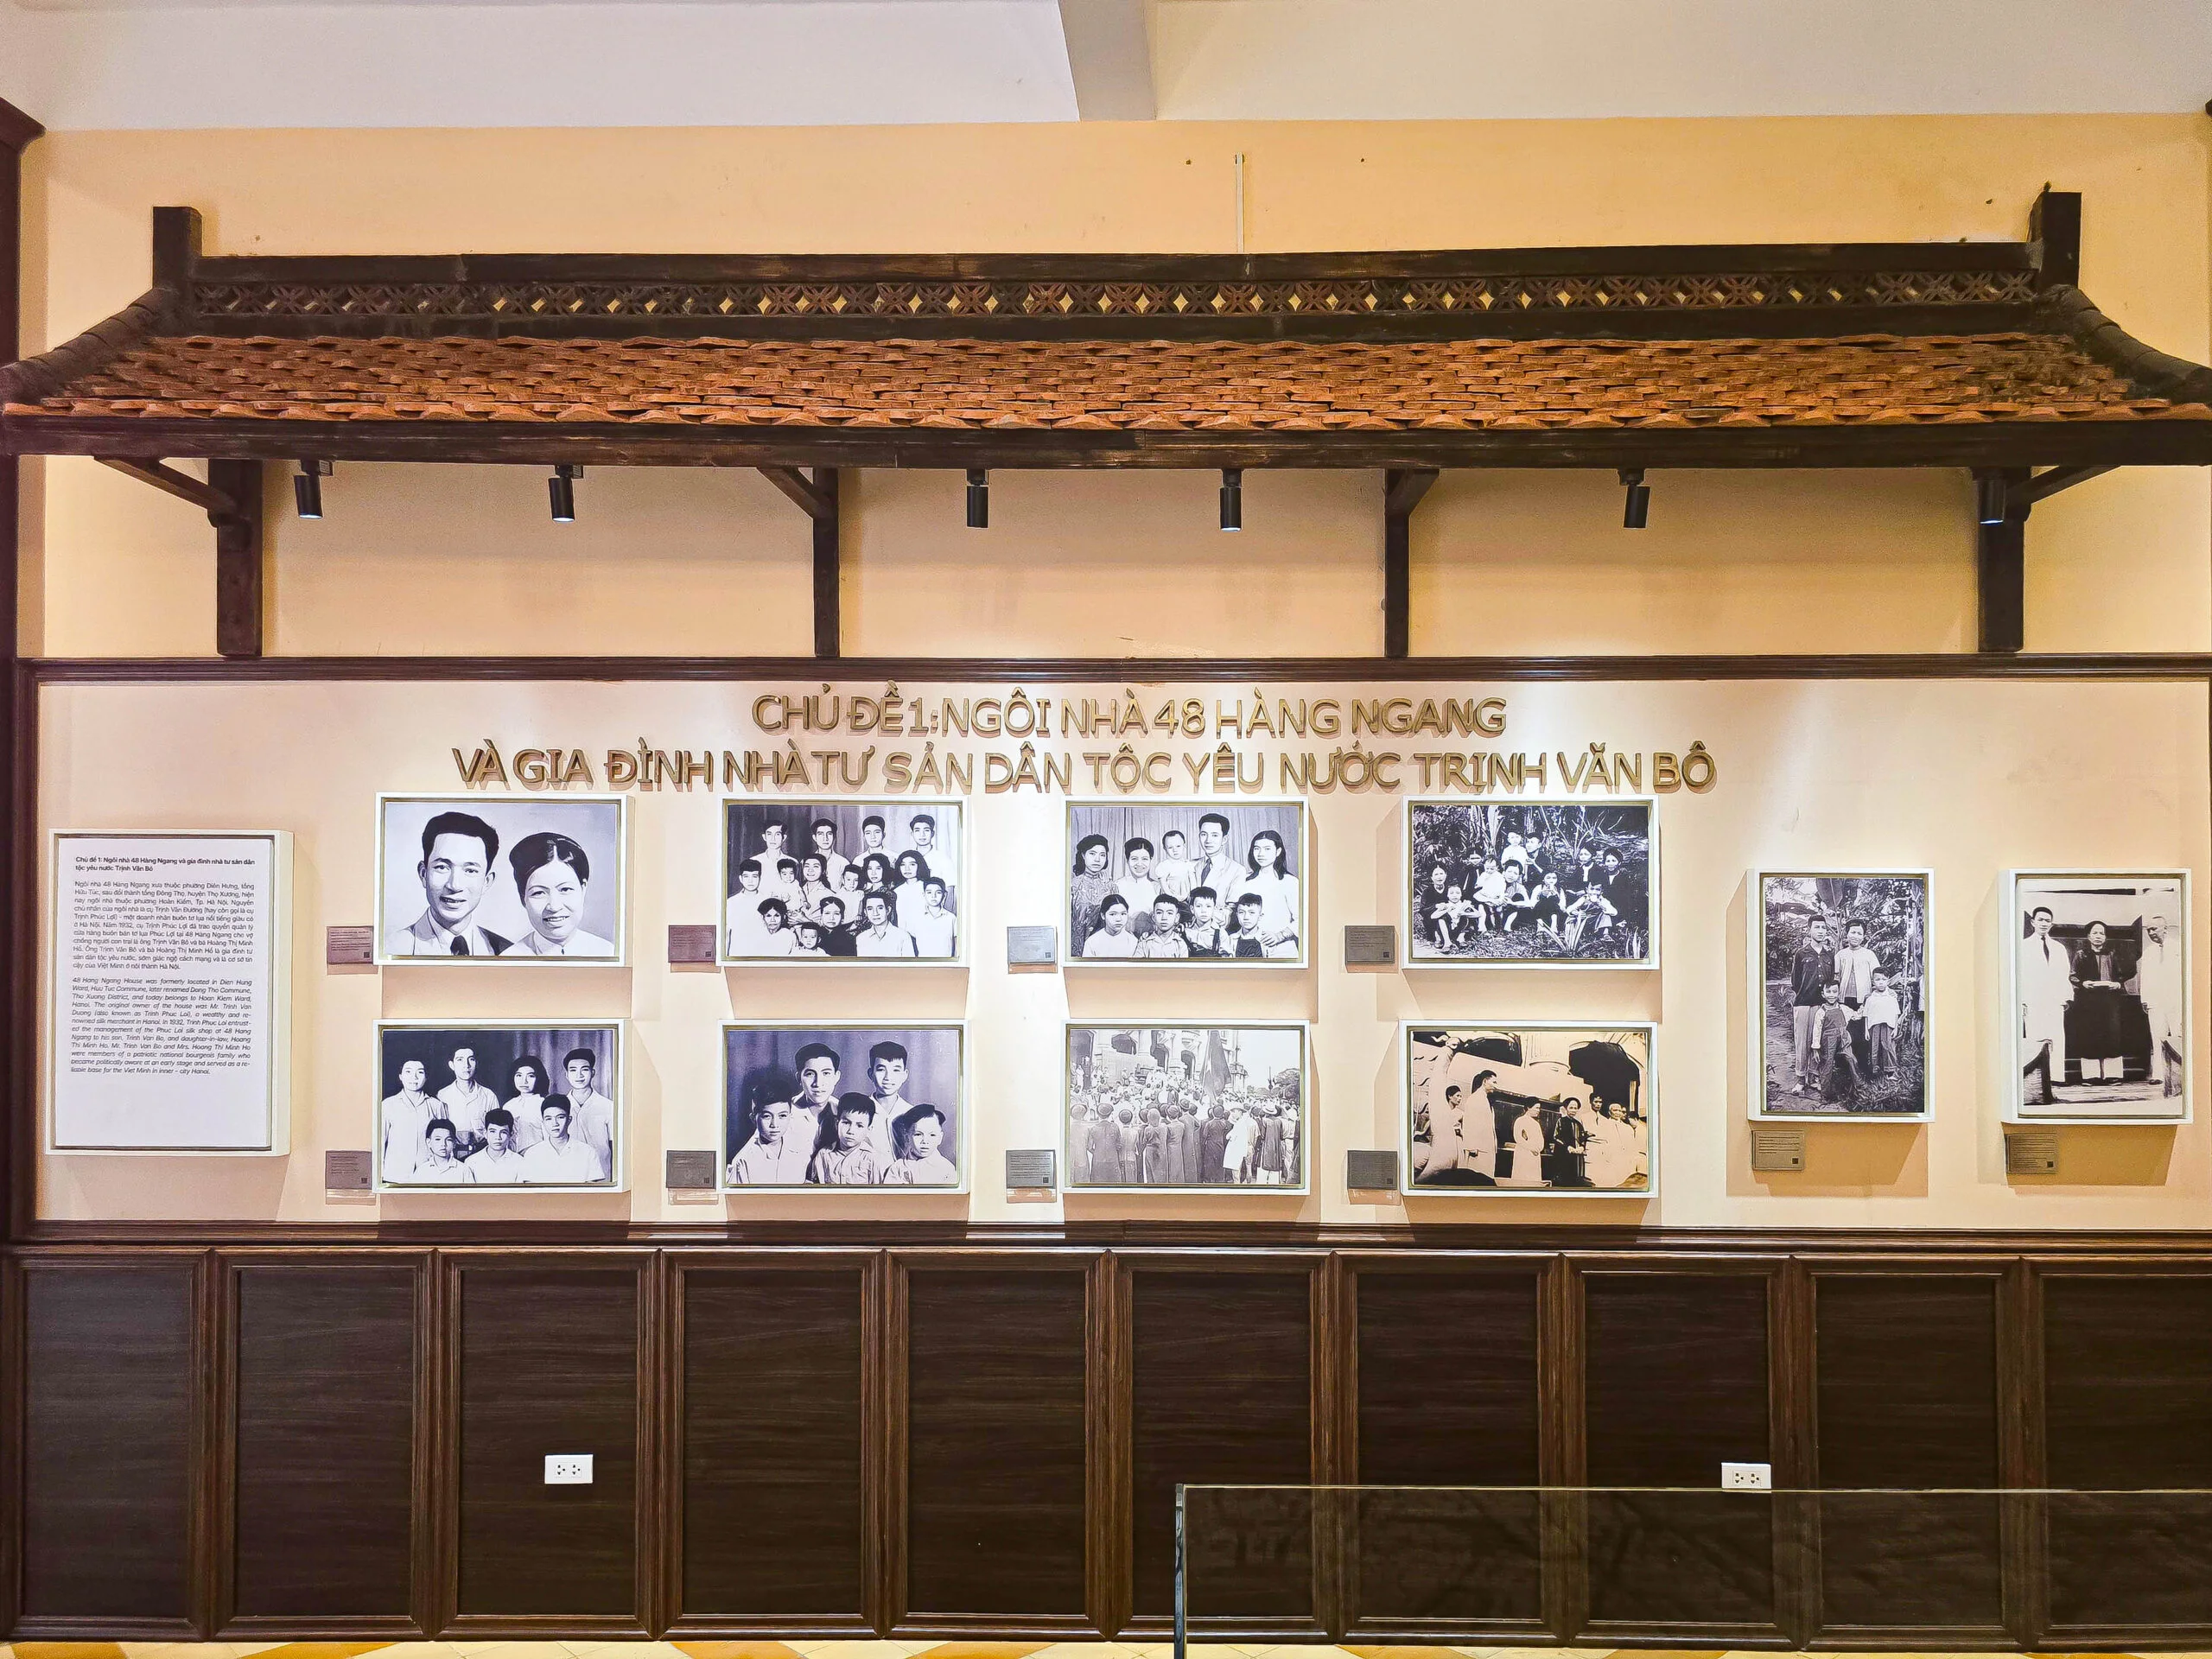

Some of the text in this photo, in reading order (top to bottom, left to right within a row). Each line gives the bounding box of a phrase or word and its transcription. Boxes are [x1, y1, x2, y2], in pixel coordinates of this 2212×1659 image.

[752, 683, 840, 731] CHỦ
[847, 679, 904, 732] ĐỀ
[943, 687, 1051, 733] NGÔI
[1061, 688, 1147, 734] NHÀ
[1154, 699, 1206, 734] 48
[1217, 687, 1340, 734] HÀNG
[1351, 697, 1507, 733] NGANG
[452, 739, 508, 784] VÀ
[513, 748, 594, 785] GIA
[604, 737, 714, 785] ĐÌNH
[723, 739, 809, 785] NHÀ
[811, 746, 875, 785] TƯ
[885, 741, 973, 786] SẢN
[985, 741, 1071, 786] DÂN
[1182, 742, 1263, 787] YÊU
[1280, 741, 1402, 787] NƯỚC
[1556, 742, 1642, 787] VĂN
[1653, 741, 1715, 787] BÔ
